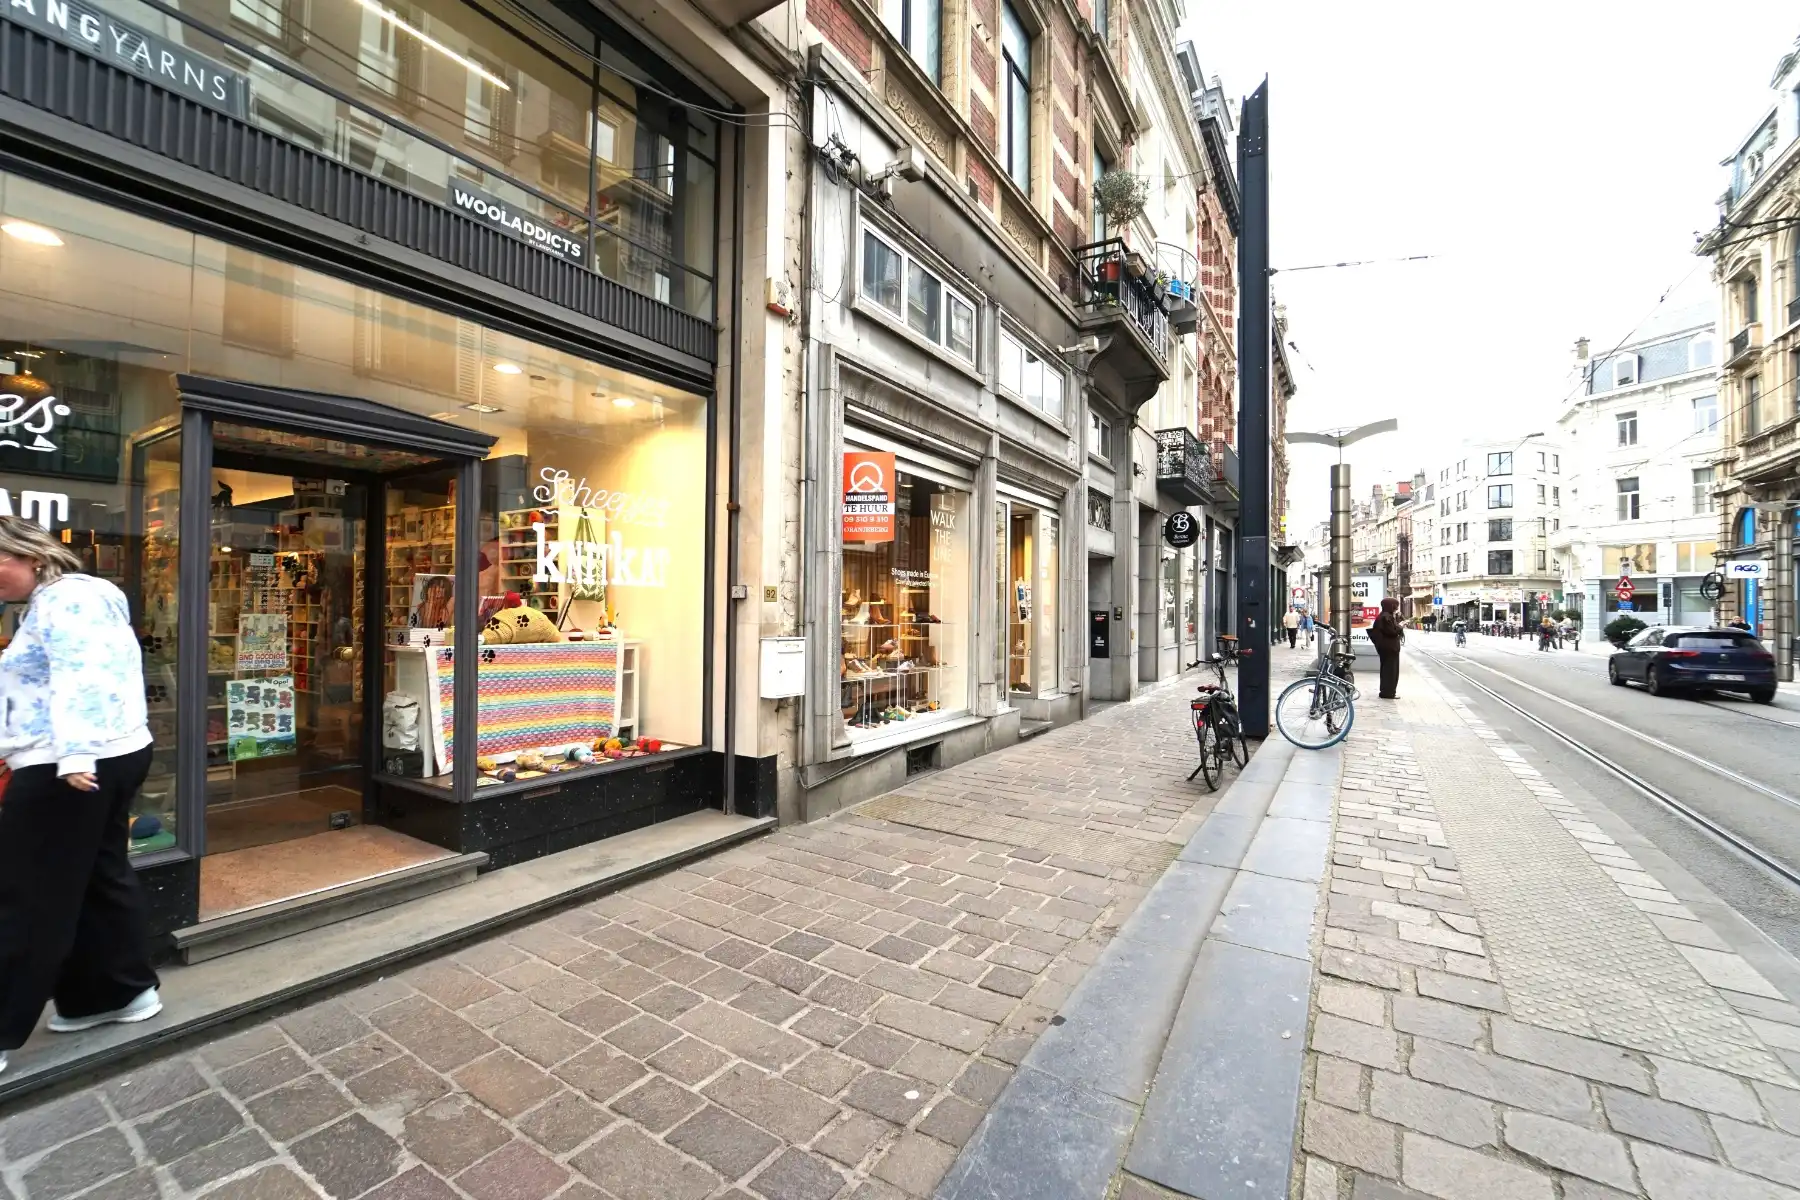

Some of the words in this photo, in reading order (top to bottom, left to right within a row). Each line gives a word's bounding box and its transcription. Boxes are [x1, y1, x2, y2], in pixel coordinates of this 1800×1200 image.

[454, 188, 581, 257] WOOLADDICTS
[845, 494, 888, 502] HANDELSPAND
[843, 504, 857, 513] TE
[859, 504, 889, 513] HUUR
[930, 509, 956, 530] WALK
[934, 528, 951, 546] THE
[933, 546, 952, 563] LINE
[765, 589, 776, 599] 92
[1366, 608, 1376, 616] 1+1
